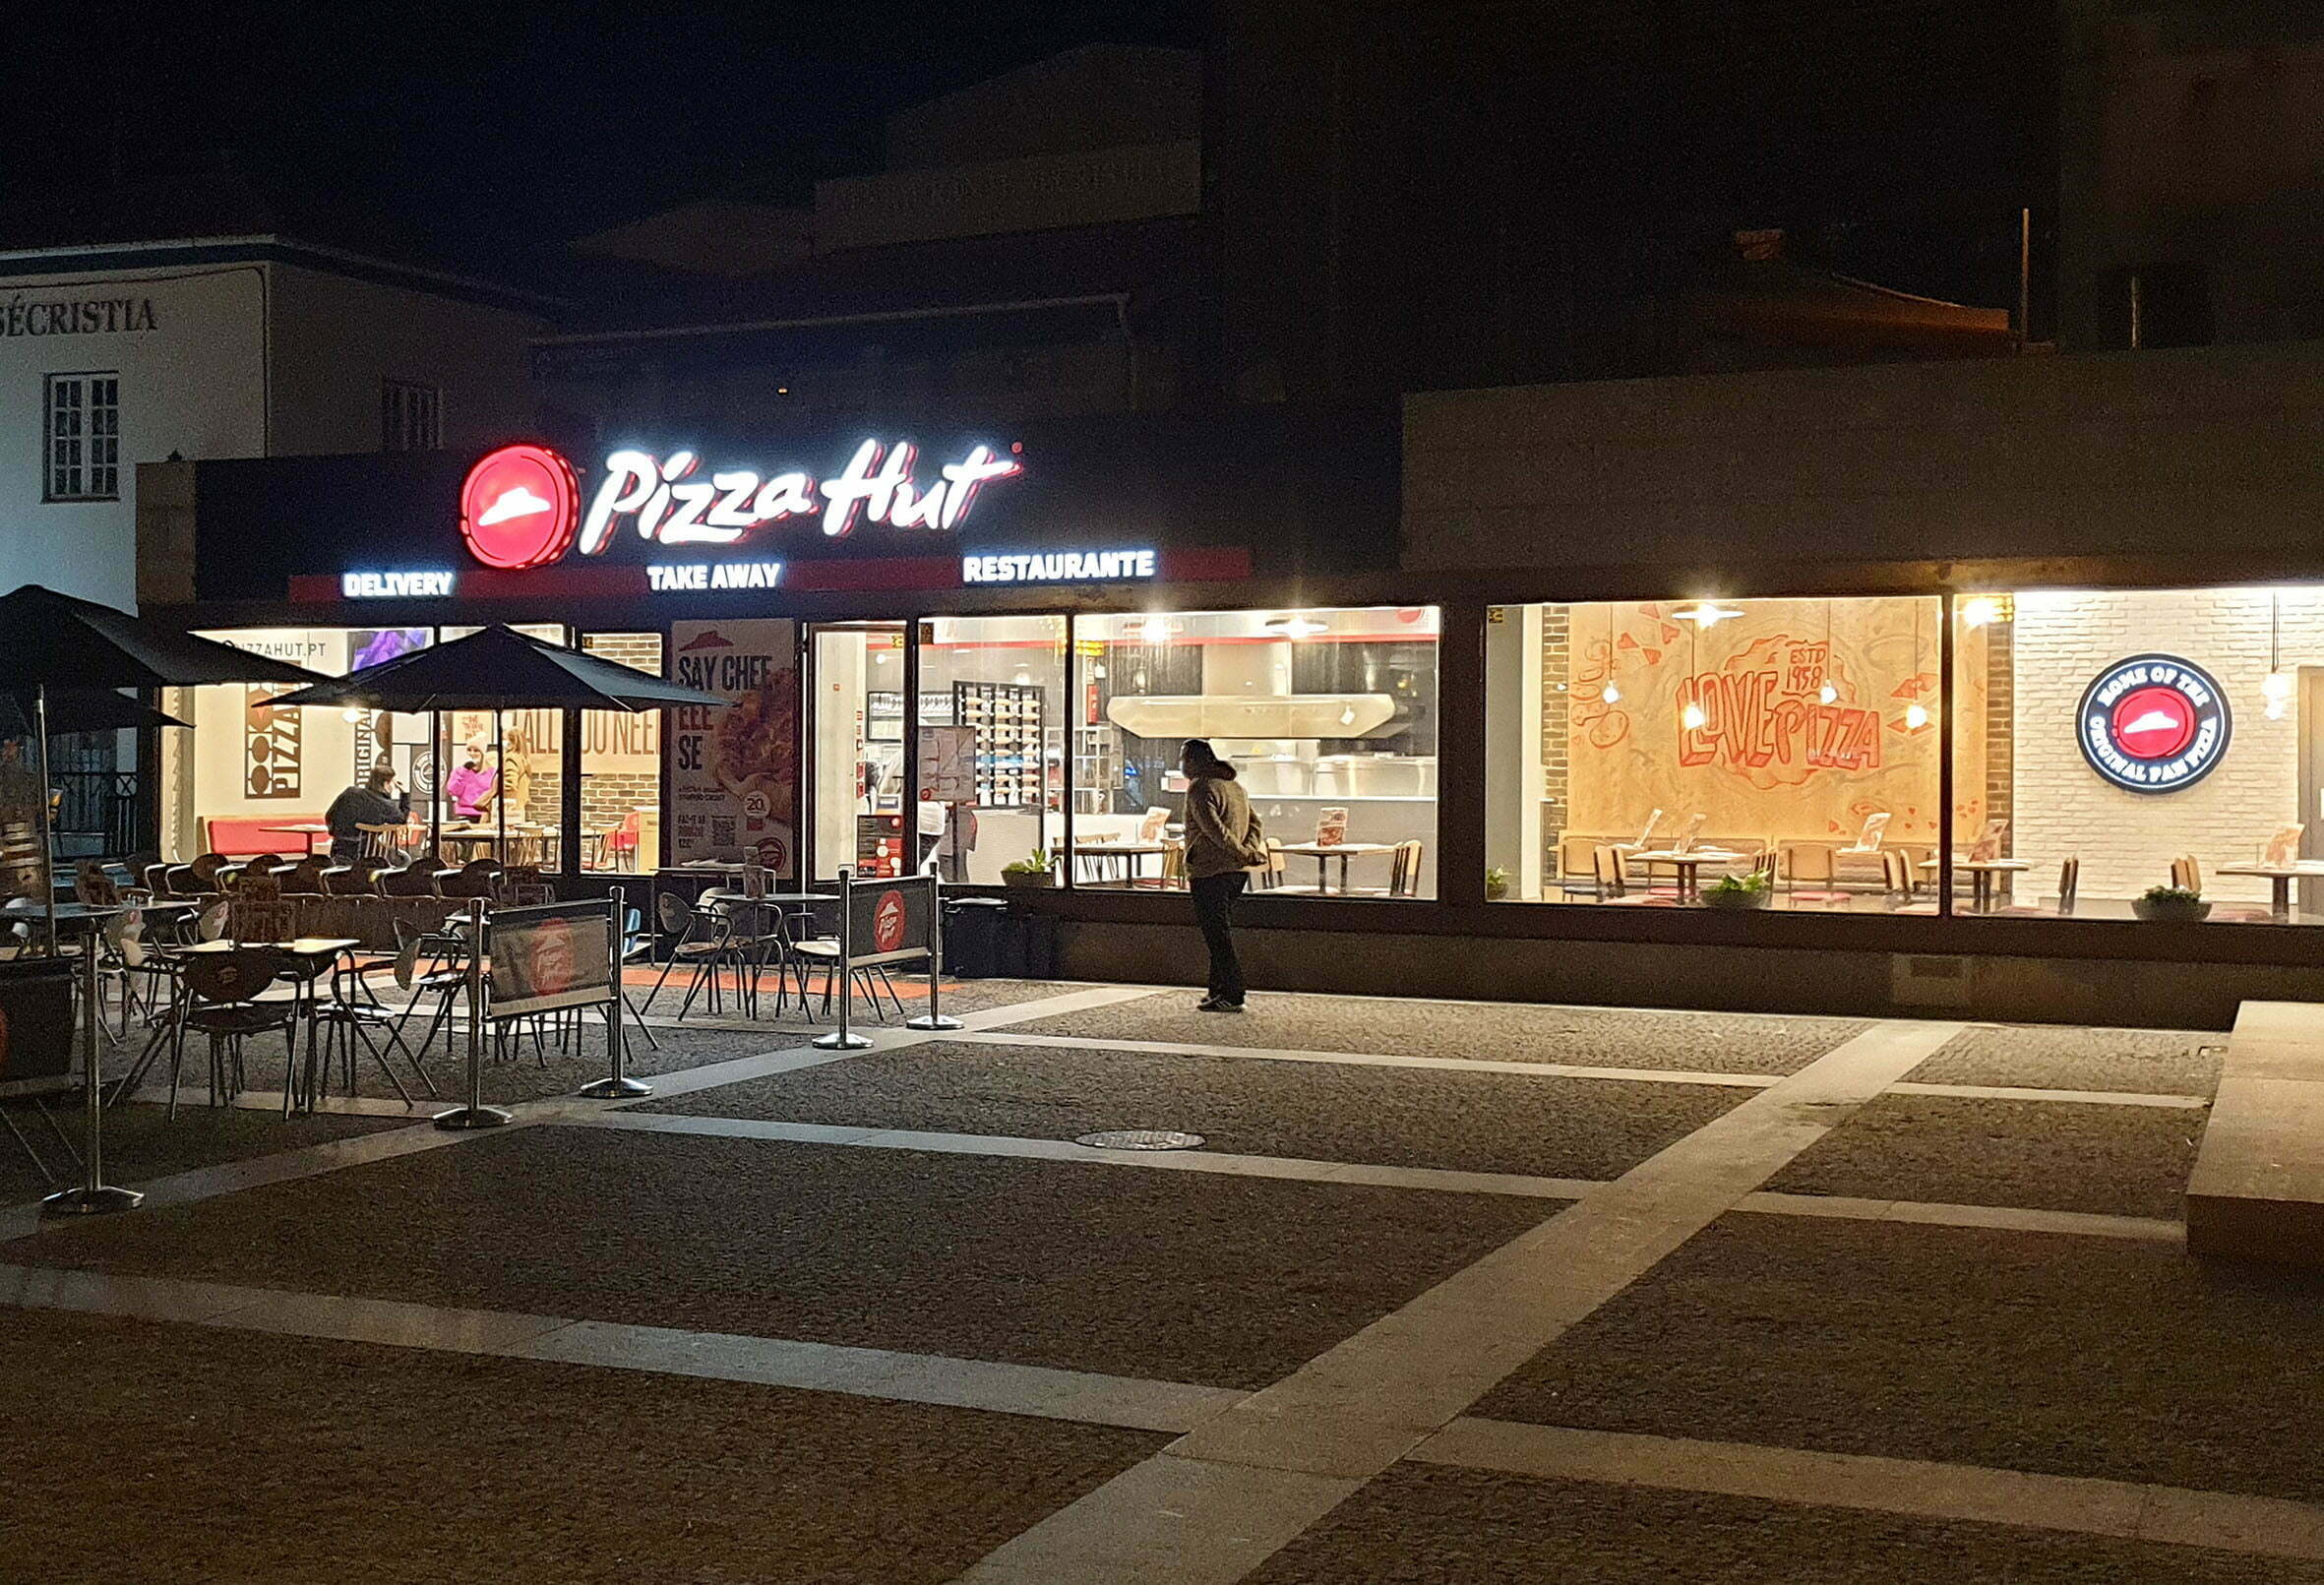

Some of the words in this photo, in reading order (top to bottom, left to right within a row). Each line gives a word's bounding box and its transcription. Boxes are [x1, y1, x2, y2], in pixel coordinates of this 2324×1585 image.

[0, 294, 157, 336] ÉCRISTIA
[579, 450, 814, 555] Pizza
[821, 438, 1019, 536] Hut
[646, 565, 708, 590] TAKE
[709, 563, 780, 589] AWAY
[963, 550, 1156, 582] RESTAURANTE
[343, 571, 454, 597] DELIVERY
[678, 655, 717, 691] SAY
[1790, 647, 1826, 664] ESTD
[1786, 665, 1823, 691] 1958
[2150, 666, 2177, 684] OF
[613, 712, 660, 755] NEE
[1676, 671, 1779, 767] LOVE
[1774, 700, 1880, 770] PIZZA
[273, 707, 301, 798] PIZZA
[678, 735, 703, 770] SE
[2090, 715, 2147, 781] ORIGINAL
[2149, 758, 2189, 782] PAN
